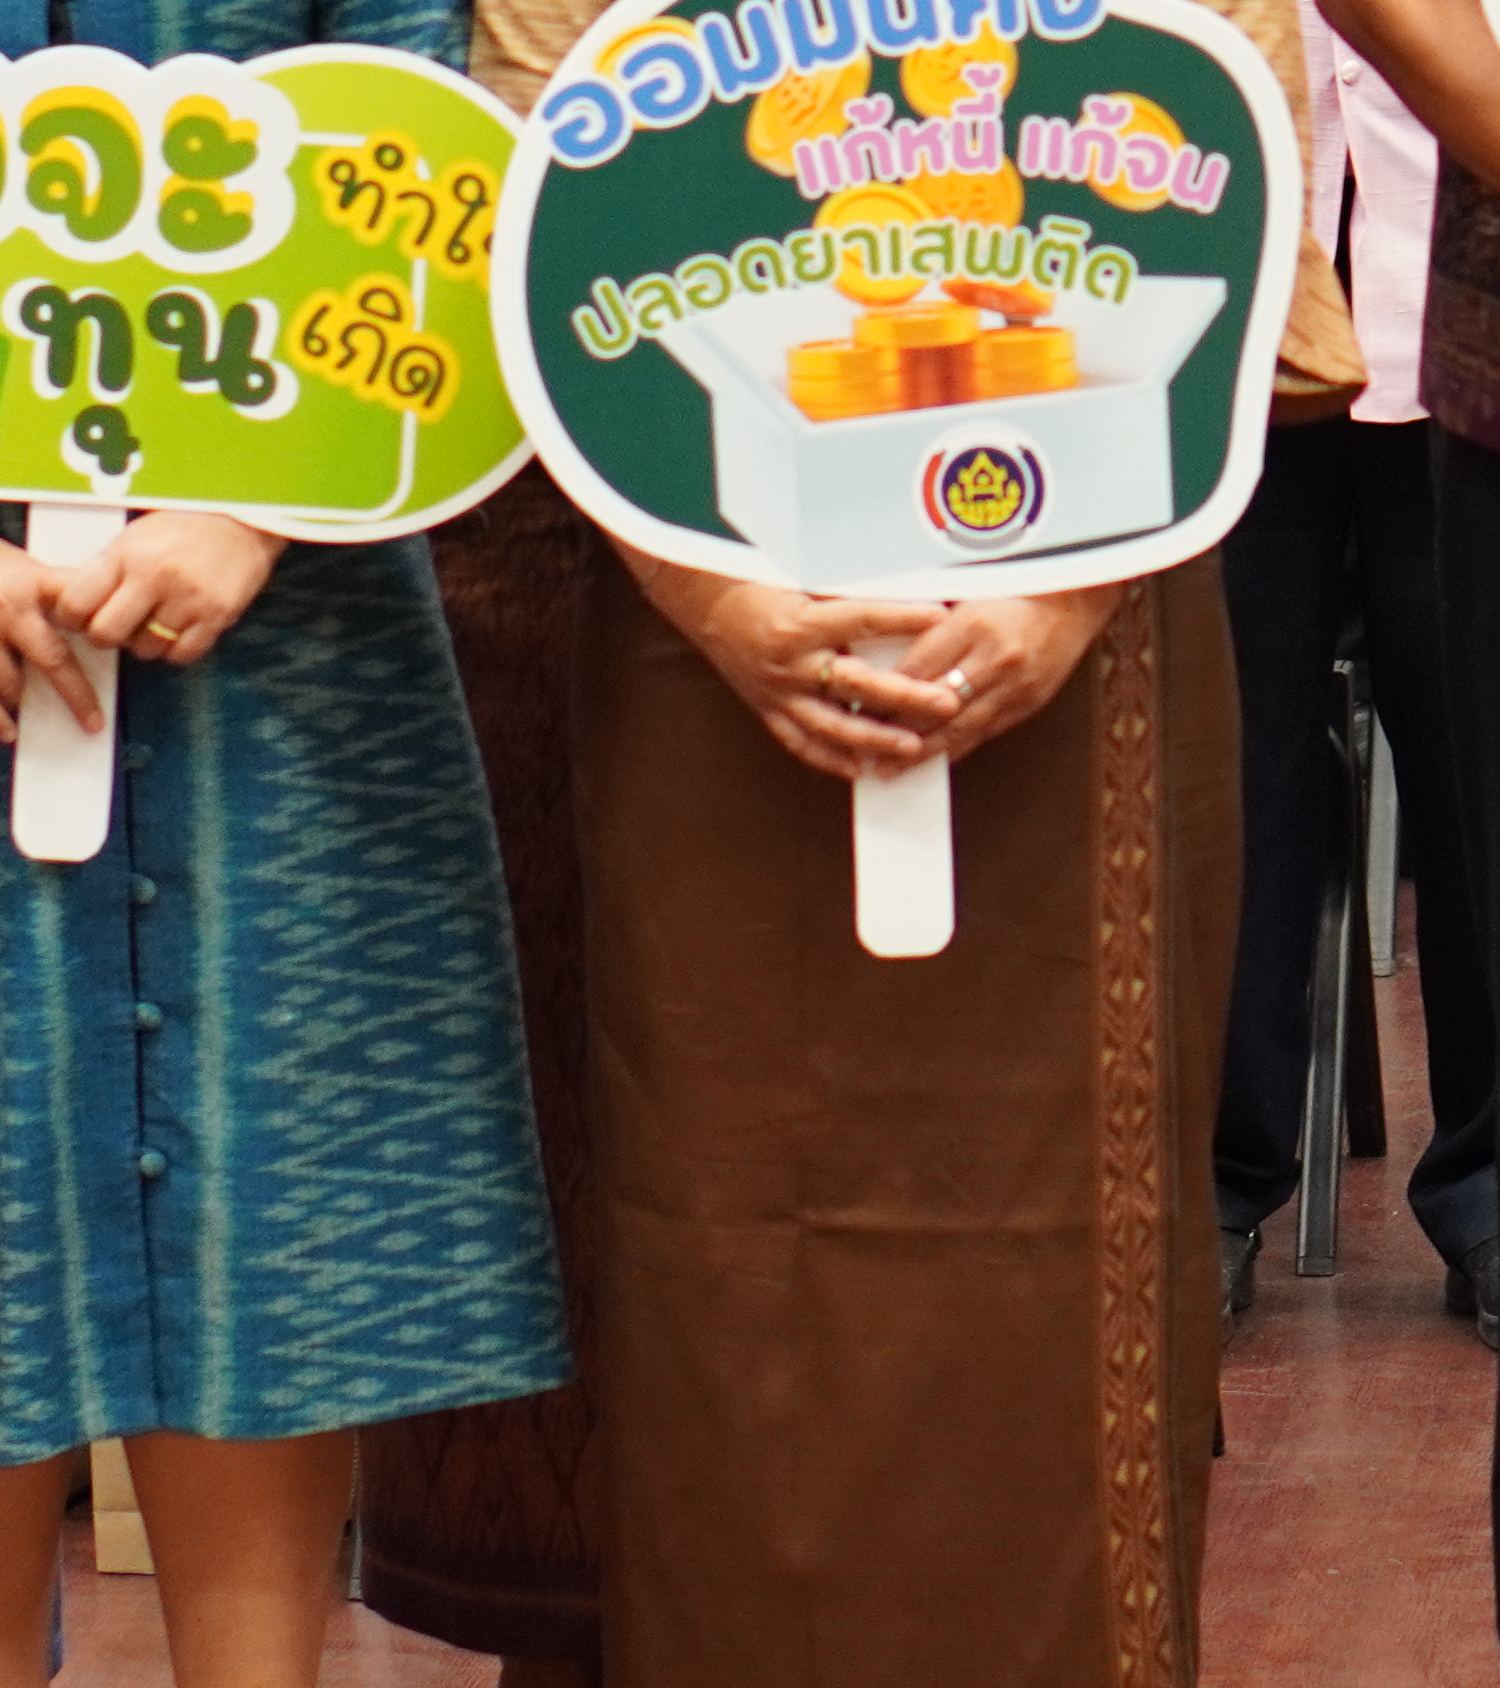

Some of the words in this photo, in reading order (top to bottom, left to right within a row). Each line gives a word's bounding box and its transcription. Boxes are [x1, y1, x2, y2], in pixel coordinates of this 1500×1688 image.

[328, 142, 494, 266] ทำใ
[796, 63, 1006, 196] แก้หนี้
[1022, 95, 1230, 211] แก้จน
[573, 216, 1137, 361] ปลอดยาเสพติด
[18, 282, 282, 477] ทุน
[300, 285, 447, 409] เกิด
